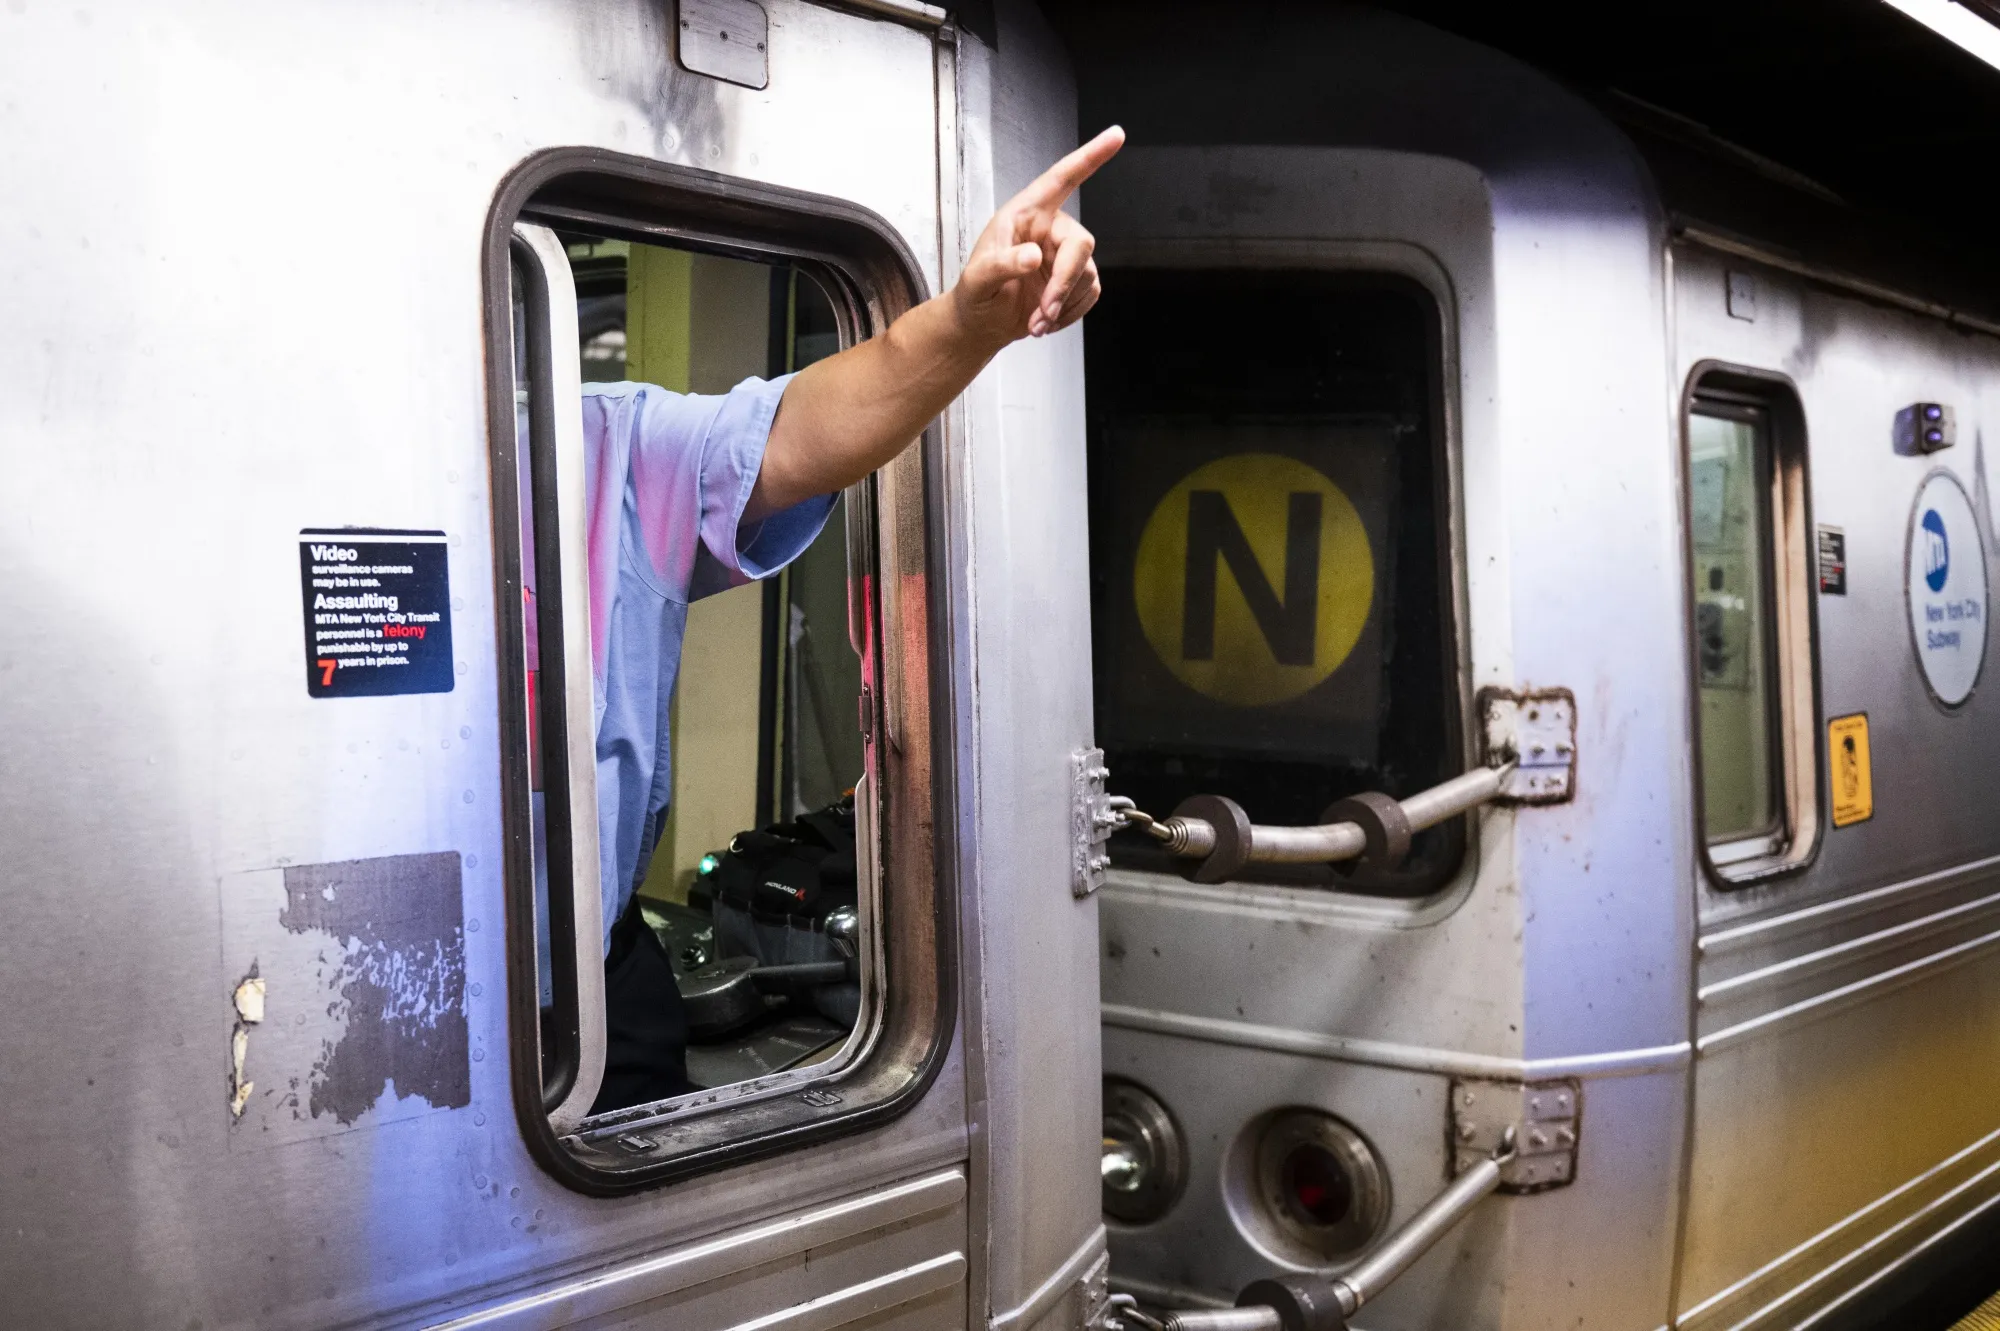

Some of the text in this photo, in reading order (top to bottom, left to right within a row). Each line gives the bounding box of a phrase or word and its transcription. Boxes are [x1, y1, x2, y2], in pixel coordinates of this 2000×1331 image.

[310, 545, 358, 561] Video
[312, 564, 413, 574] surveillance cameras
[313, 577, 381, 589] may be in use.
[1181, 490, 1324, 666] N
[314, 593, 398, 611] Assaulting
[1926, 599, 1944, 622] New
[1946, 597, 1964, 619] York
[315, 612, 440, 624] MTA New York City Transit
[316, 629, 365, 641] personnel
[366, 628, 375, 638] is
[383, 624, 426, 640] felony
[1927, 628, 1960, 652] Subway
[317, 642, 409, 655] punishable by up to
[317, 655, 409, 686] 7 years in prison.
